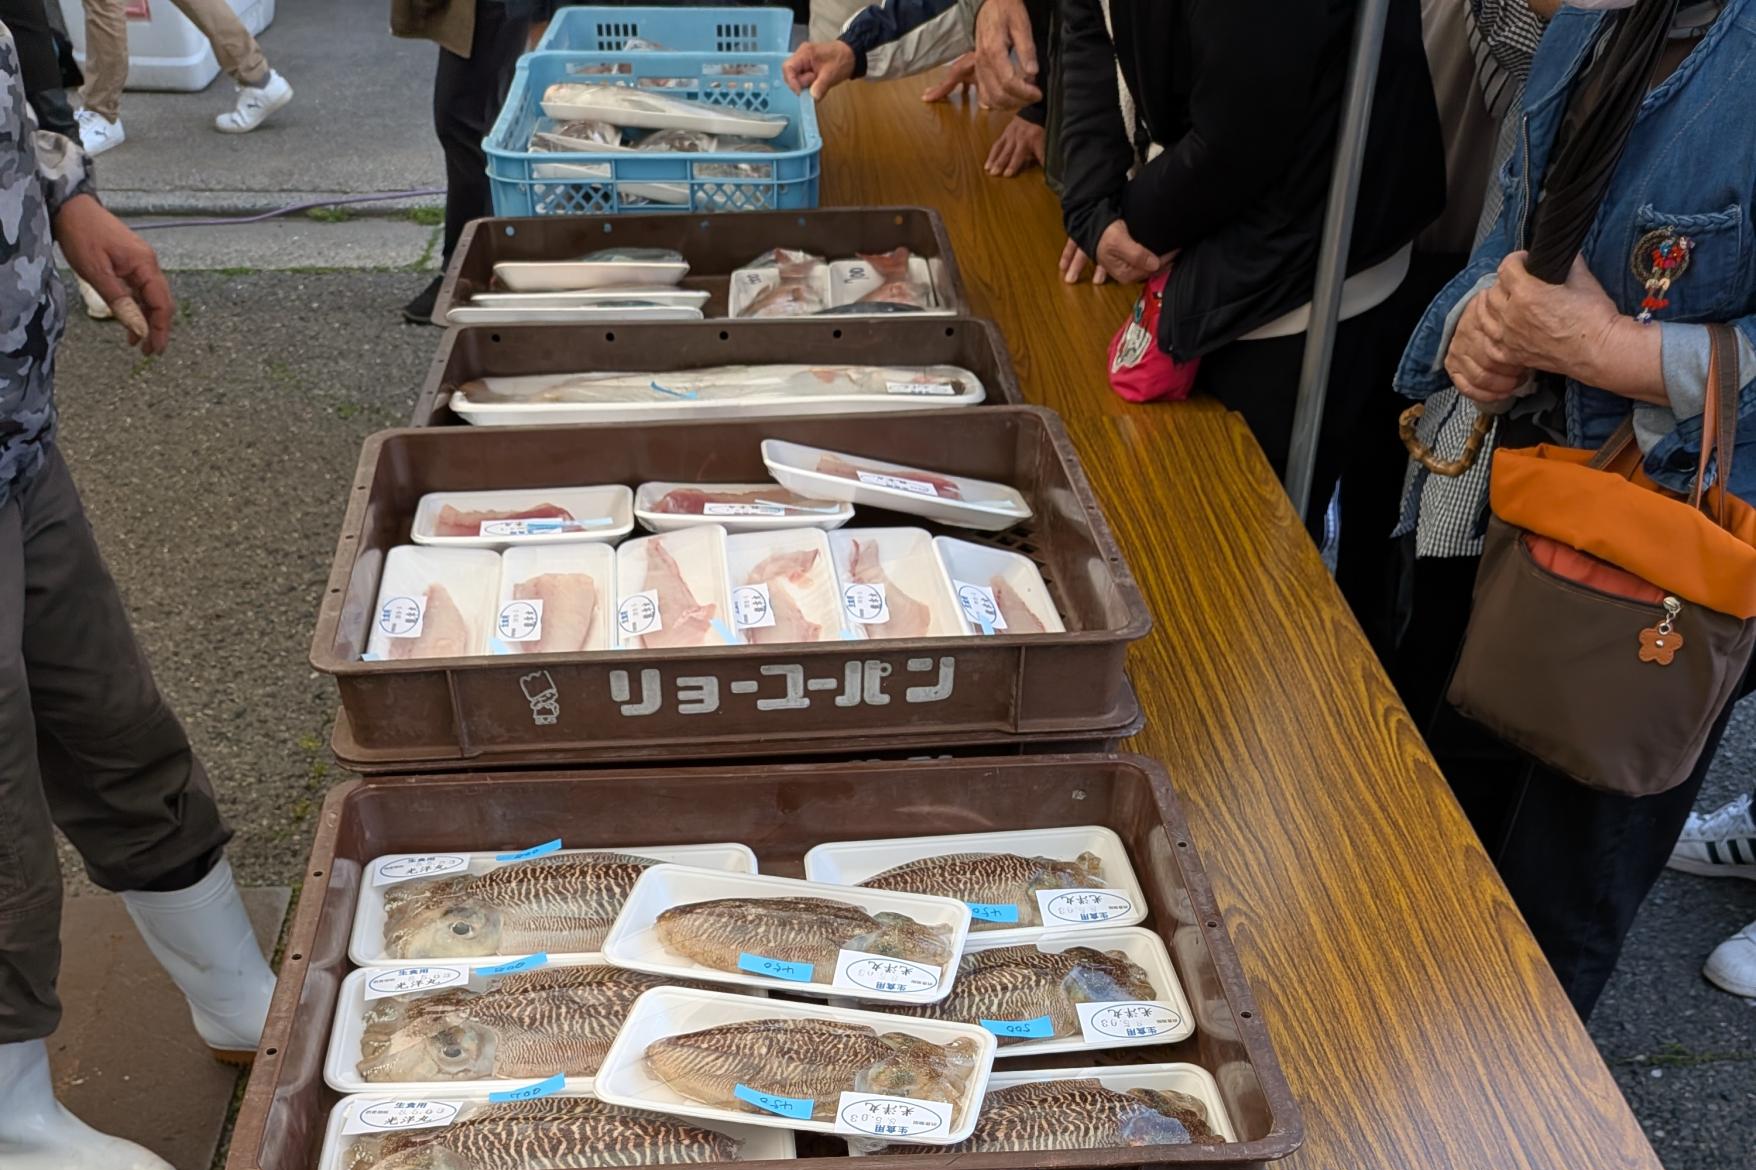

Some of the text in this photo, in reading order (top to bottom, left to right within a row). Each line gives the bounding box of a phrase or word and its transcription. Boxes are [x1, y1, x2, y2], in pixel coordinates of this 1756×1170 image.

[609, 656, 955, 716] リョーユーパン
[972, 907, 1002, 917] 450
[763, 962, 795, 975] 450
[868, 960, 914, 977] 光洋丸
[876, 981, 908, 991] 生食用
[1107, 1007, 1154, 1019] 光洋丸
[1006, 1023, 1030, 1032] 500
[1126, 1026, 1158, 1037] 生食用
[759, 1097, 793, 1110] 450
[864, 1101, 915, 1115] 光洋丸
[874, 1124, 909, 1135] 生食用
